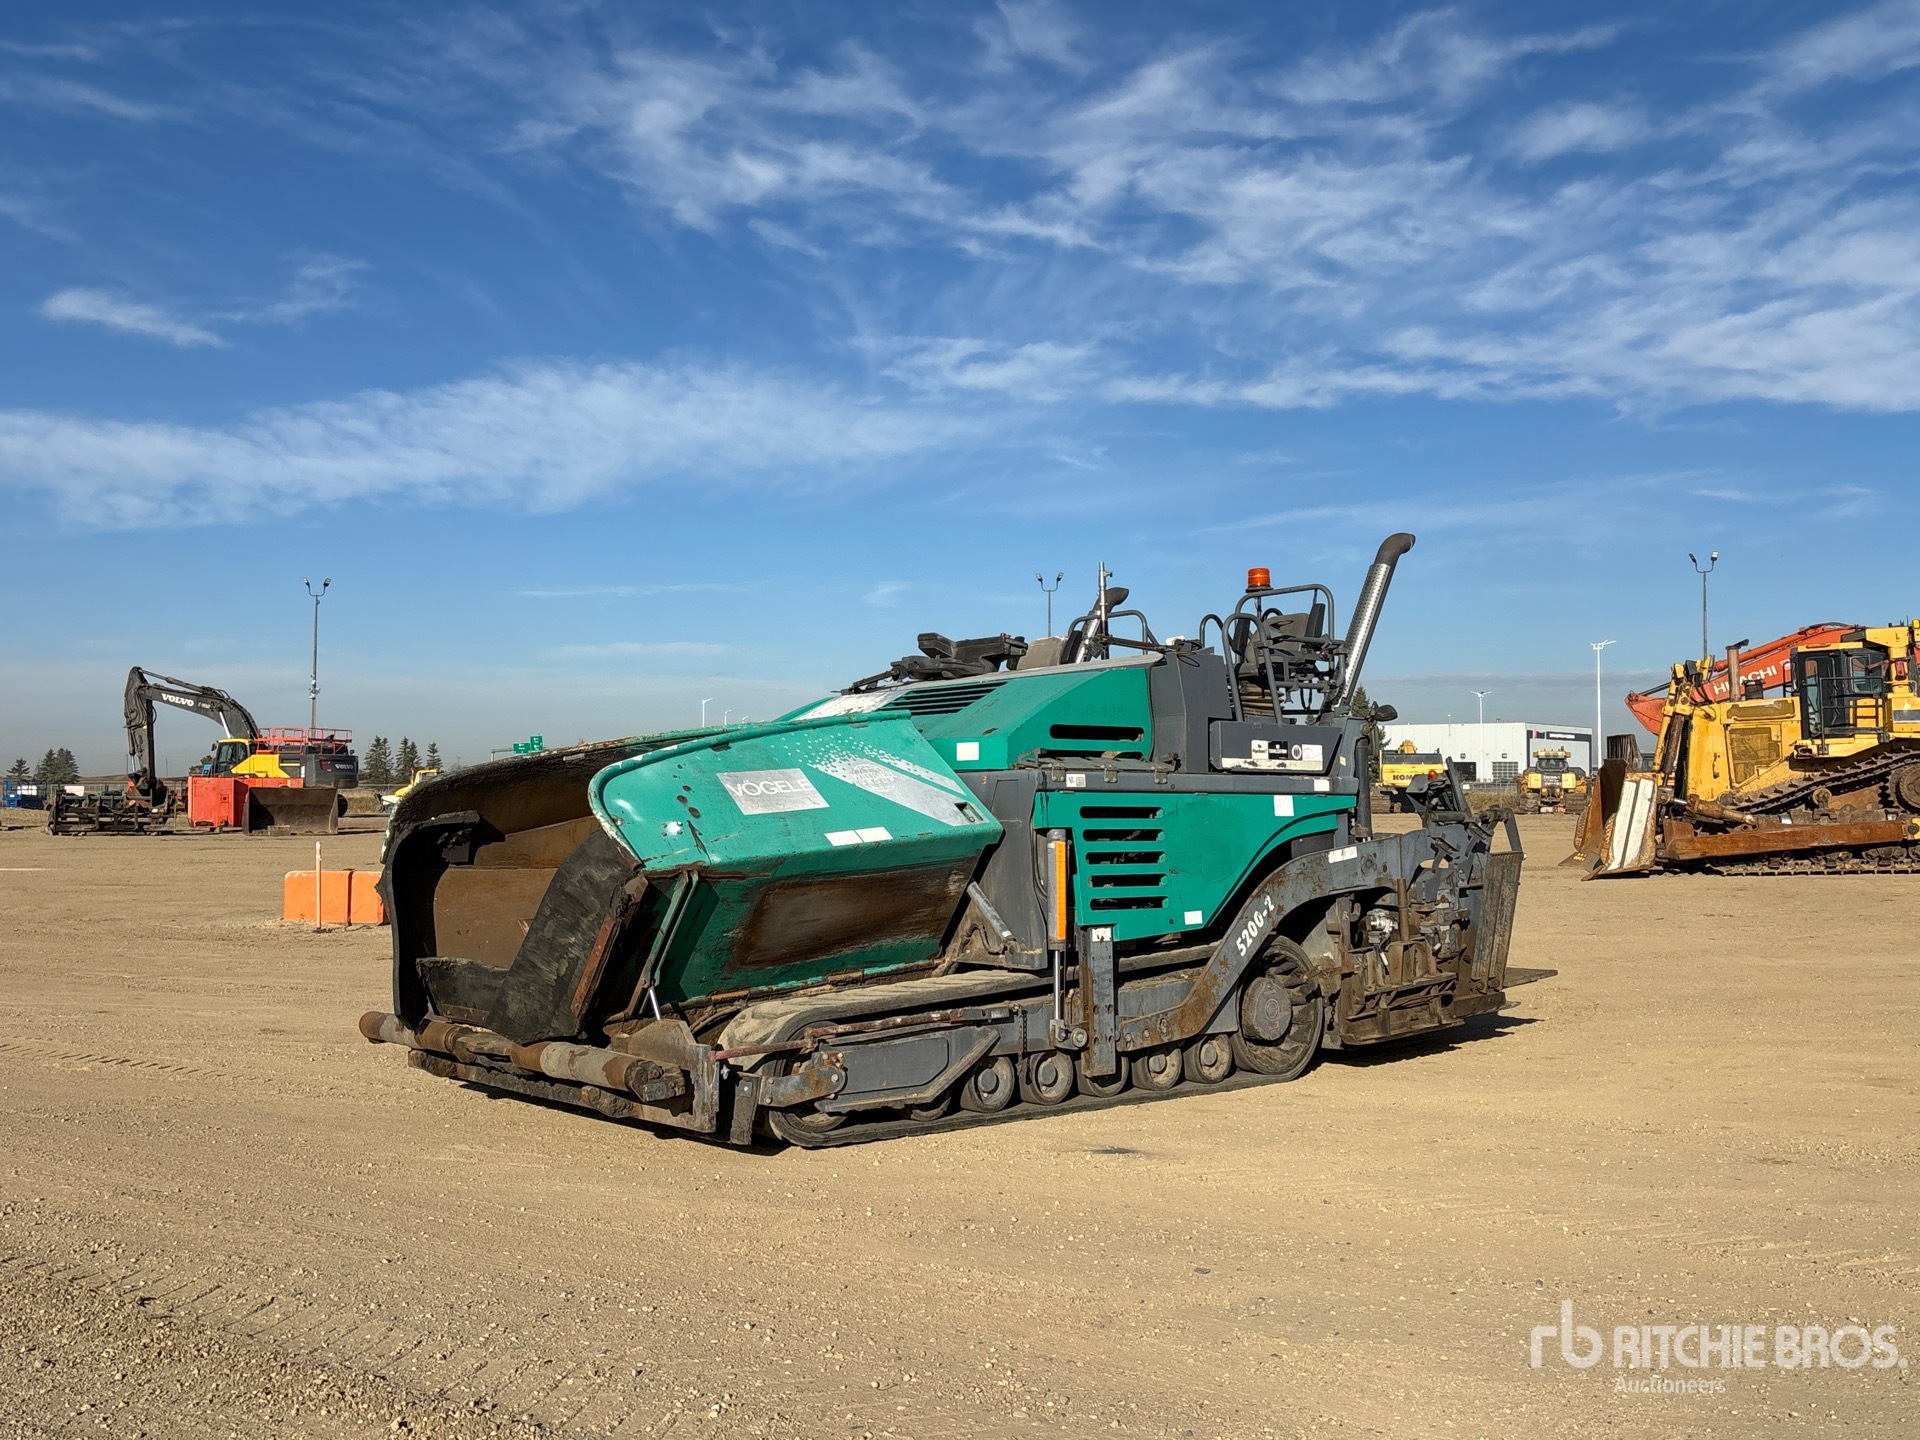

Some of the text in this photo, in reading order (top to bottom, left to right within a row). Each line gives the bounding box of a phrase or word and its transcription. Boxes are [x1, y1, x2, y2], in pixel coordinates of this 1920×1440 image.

[1713, 664, 1778, 695] HIACHI
[161, 693, 195, 707] VOLVO
[726, 779, 815, 796] VÖGELE
[1235, 895, 1275, 957] 5200-2
